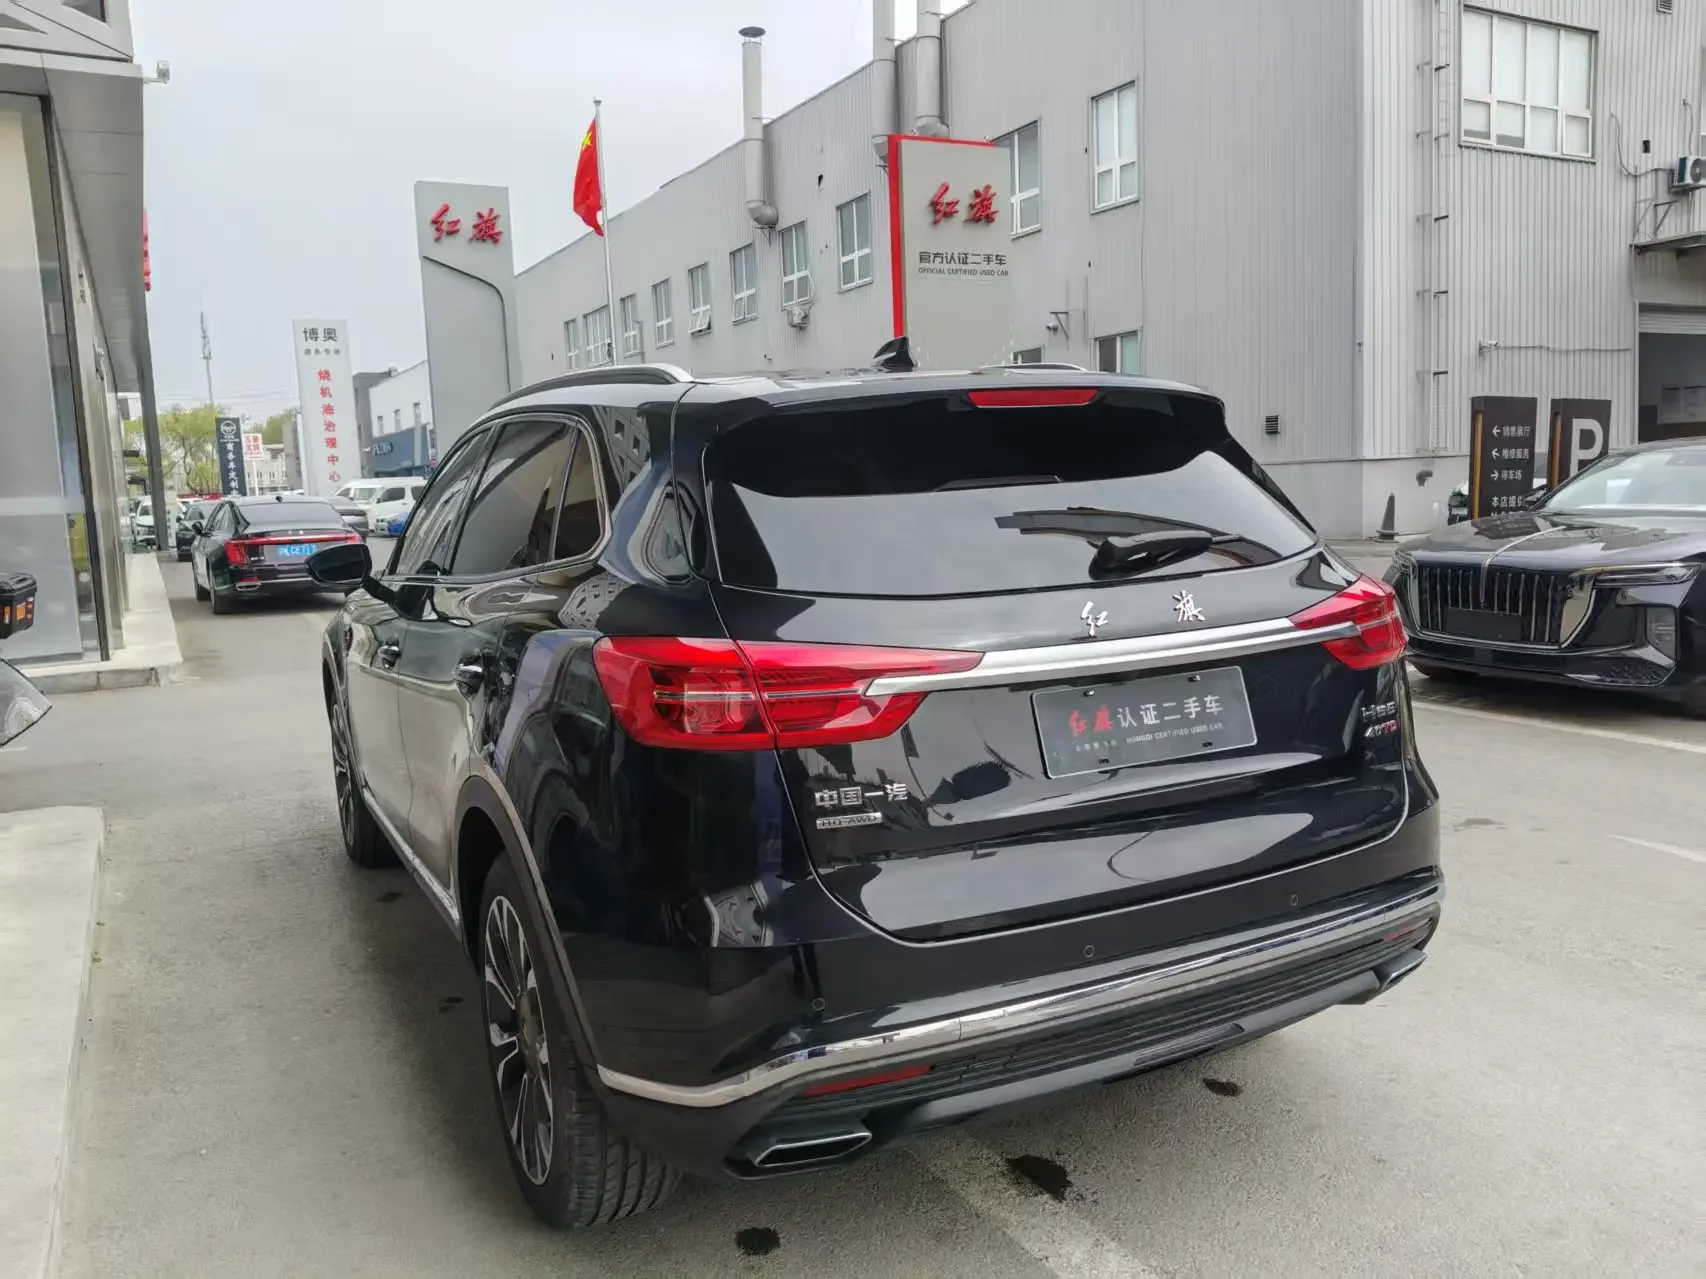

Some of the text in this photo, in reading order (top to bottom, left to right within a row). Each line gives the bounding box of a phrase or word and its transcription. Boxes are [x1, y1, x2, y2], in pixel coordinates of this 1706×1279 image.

[929, 182, 1000, 224] 红旗
[431, 203, 503, 244] 红旗
[919, 251, 1007, 266] 官方认证二手车
[918, 267, 946, 275] OFFICIAL
[947, 268, 978, 276] CERTIFIED
[302, 327, 338, 342] 博奥
[317, 368, 341, 482] 烧机油治理中心
[1502, 425, 1531, 438] 销售展厅
[1502, 448, 1530, 460] 维修服务
[1569, 418, 1604, 478] P
[1501, 470, 1522, 481] 停车场
[1126, 722, 1223, 744] HONGQI CERTIFIED USED CAR
[814, 783, 908, 809] 中国一汽
[821, 814, 877, 827] HQ-AWD
